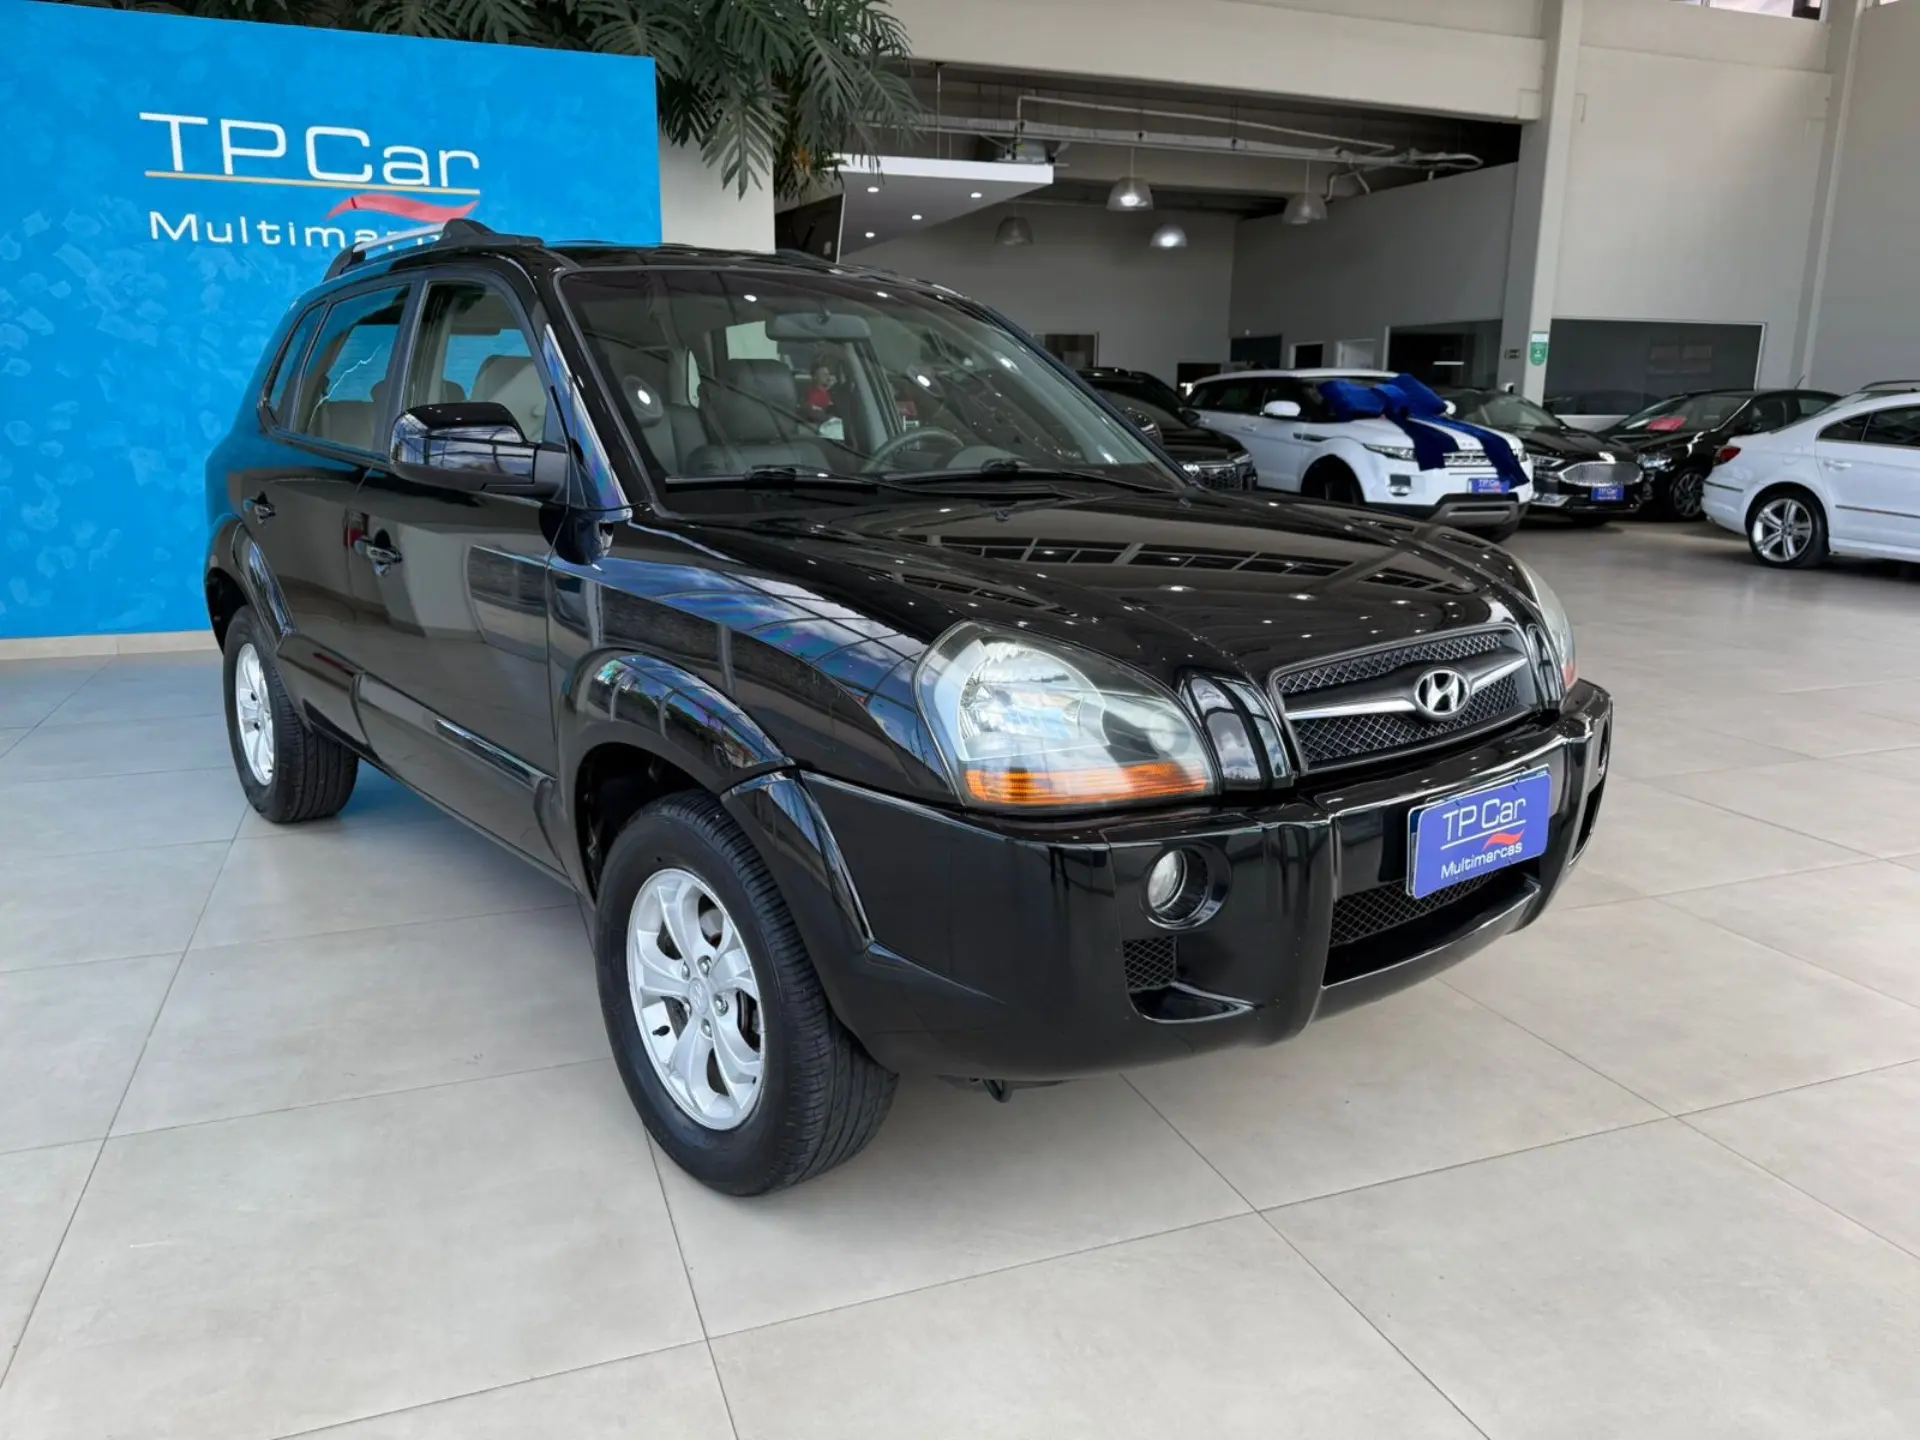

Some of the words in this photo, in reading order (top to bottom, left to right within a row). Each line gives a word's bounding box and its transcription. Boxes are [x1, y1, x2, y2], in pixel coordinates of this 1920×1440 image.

[149, 211, 440, 250] Multima
[1481, 798, 1526, 828] Car
[1442, 842, 1522, 879] Multimarcas
